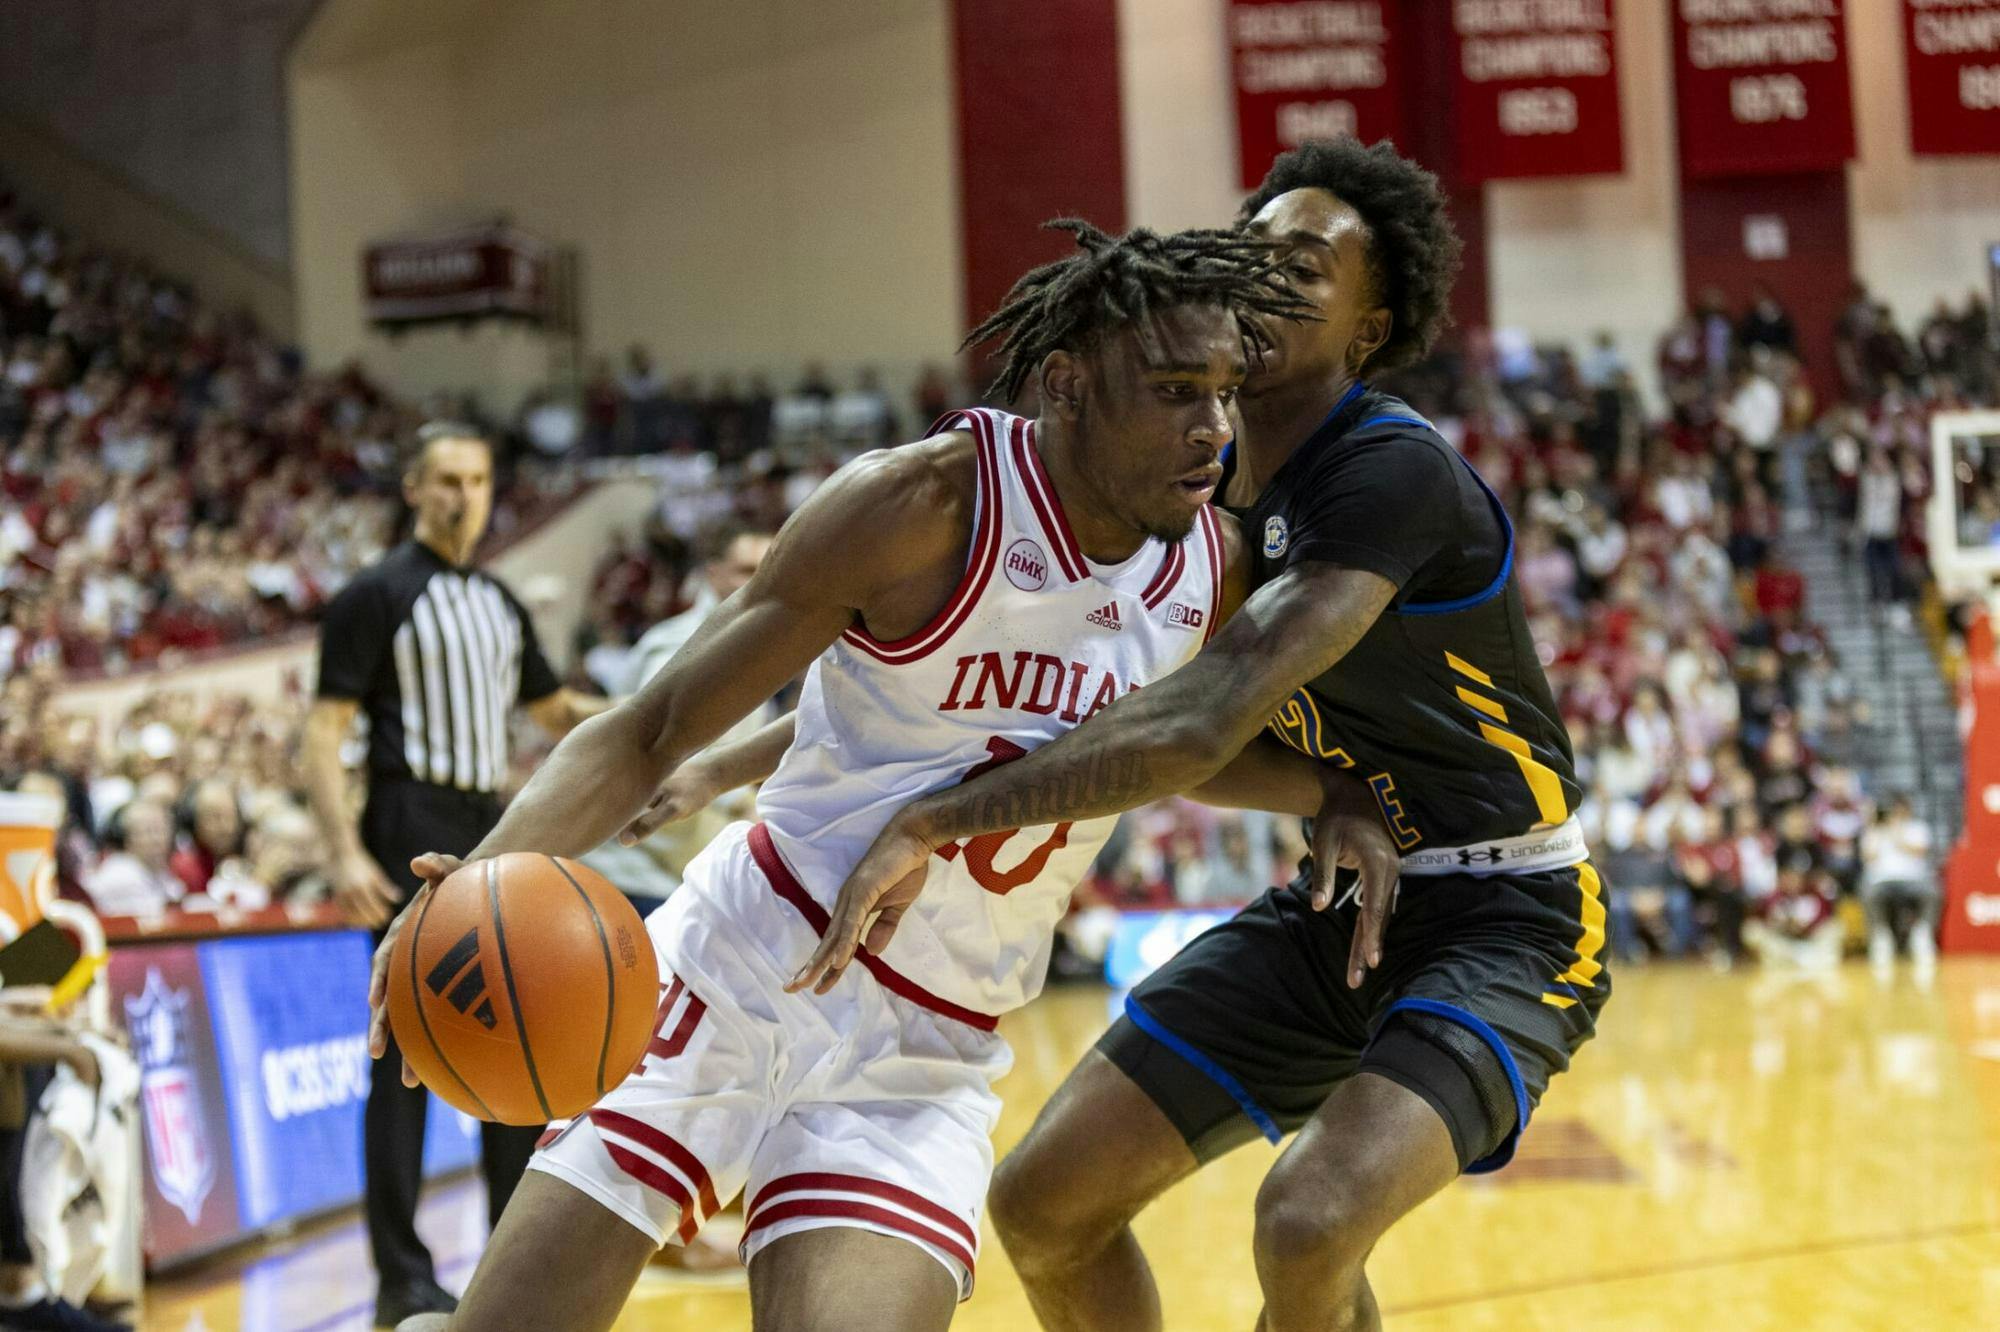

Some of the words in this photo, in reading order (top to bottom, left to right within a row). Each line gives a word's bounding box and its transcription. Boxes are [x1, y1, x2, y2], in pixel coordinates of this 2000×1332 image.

[1008, 552, 1044, 582] RMK
[1086, 612, 1123, 631] adidas
[938, 651, 1142, 724] INDIA
[1404, 853, 1452, 866] UNDE
